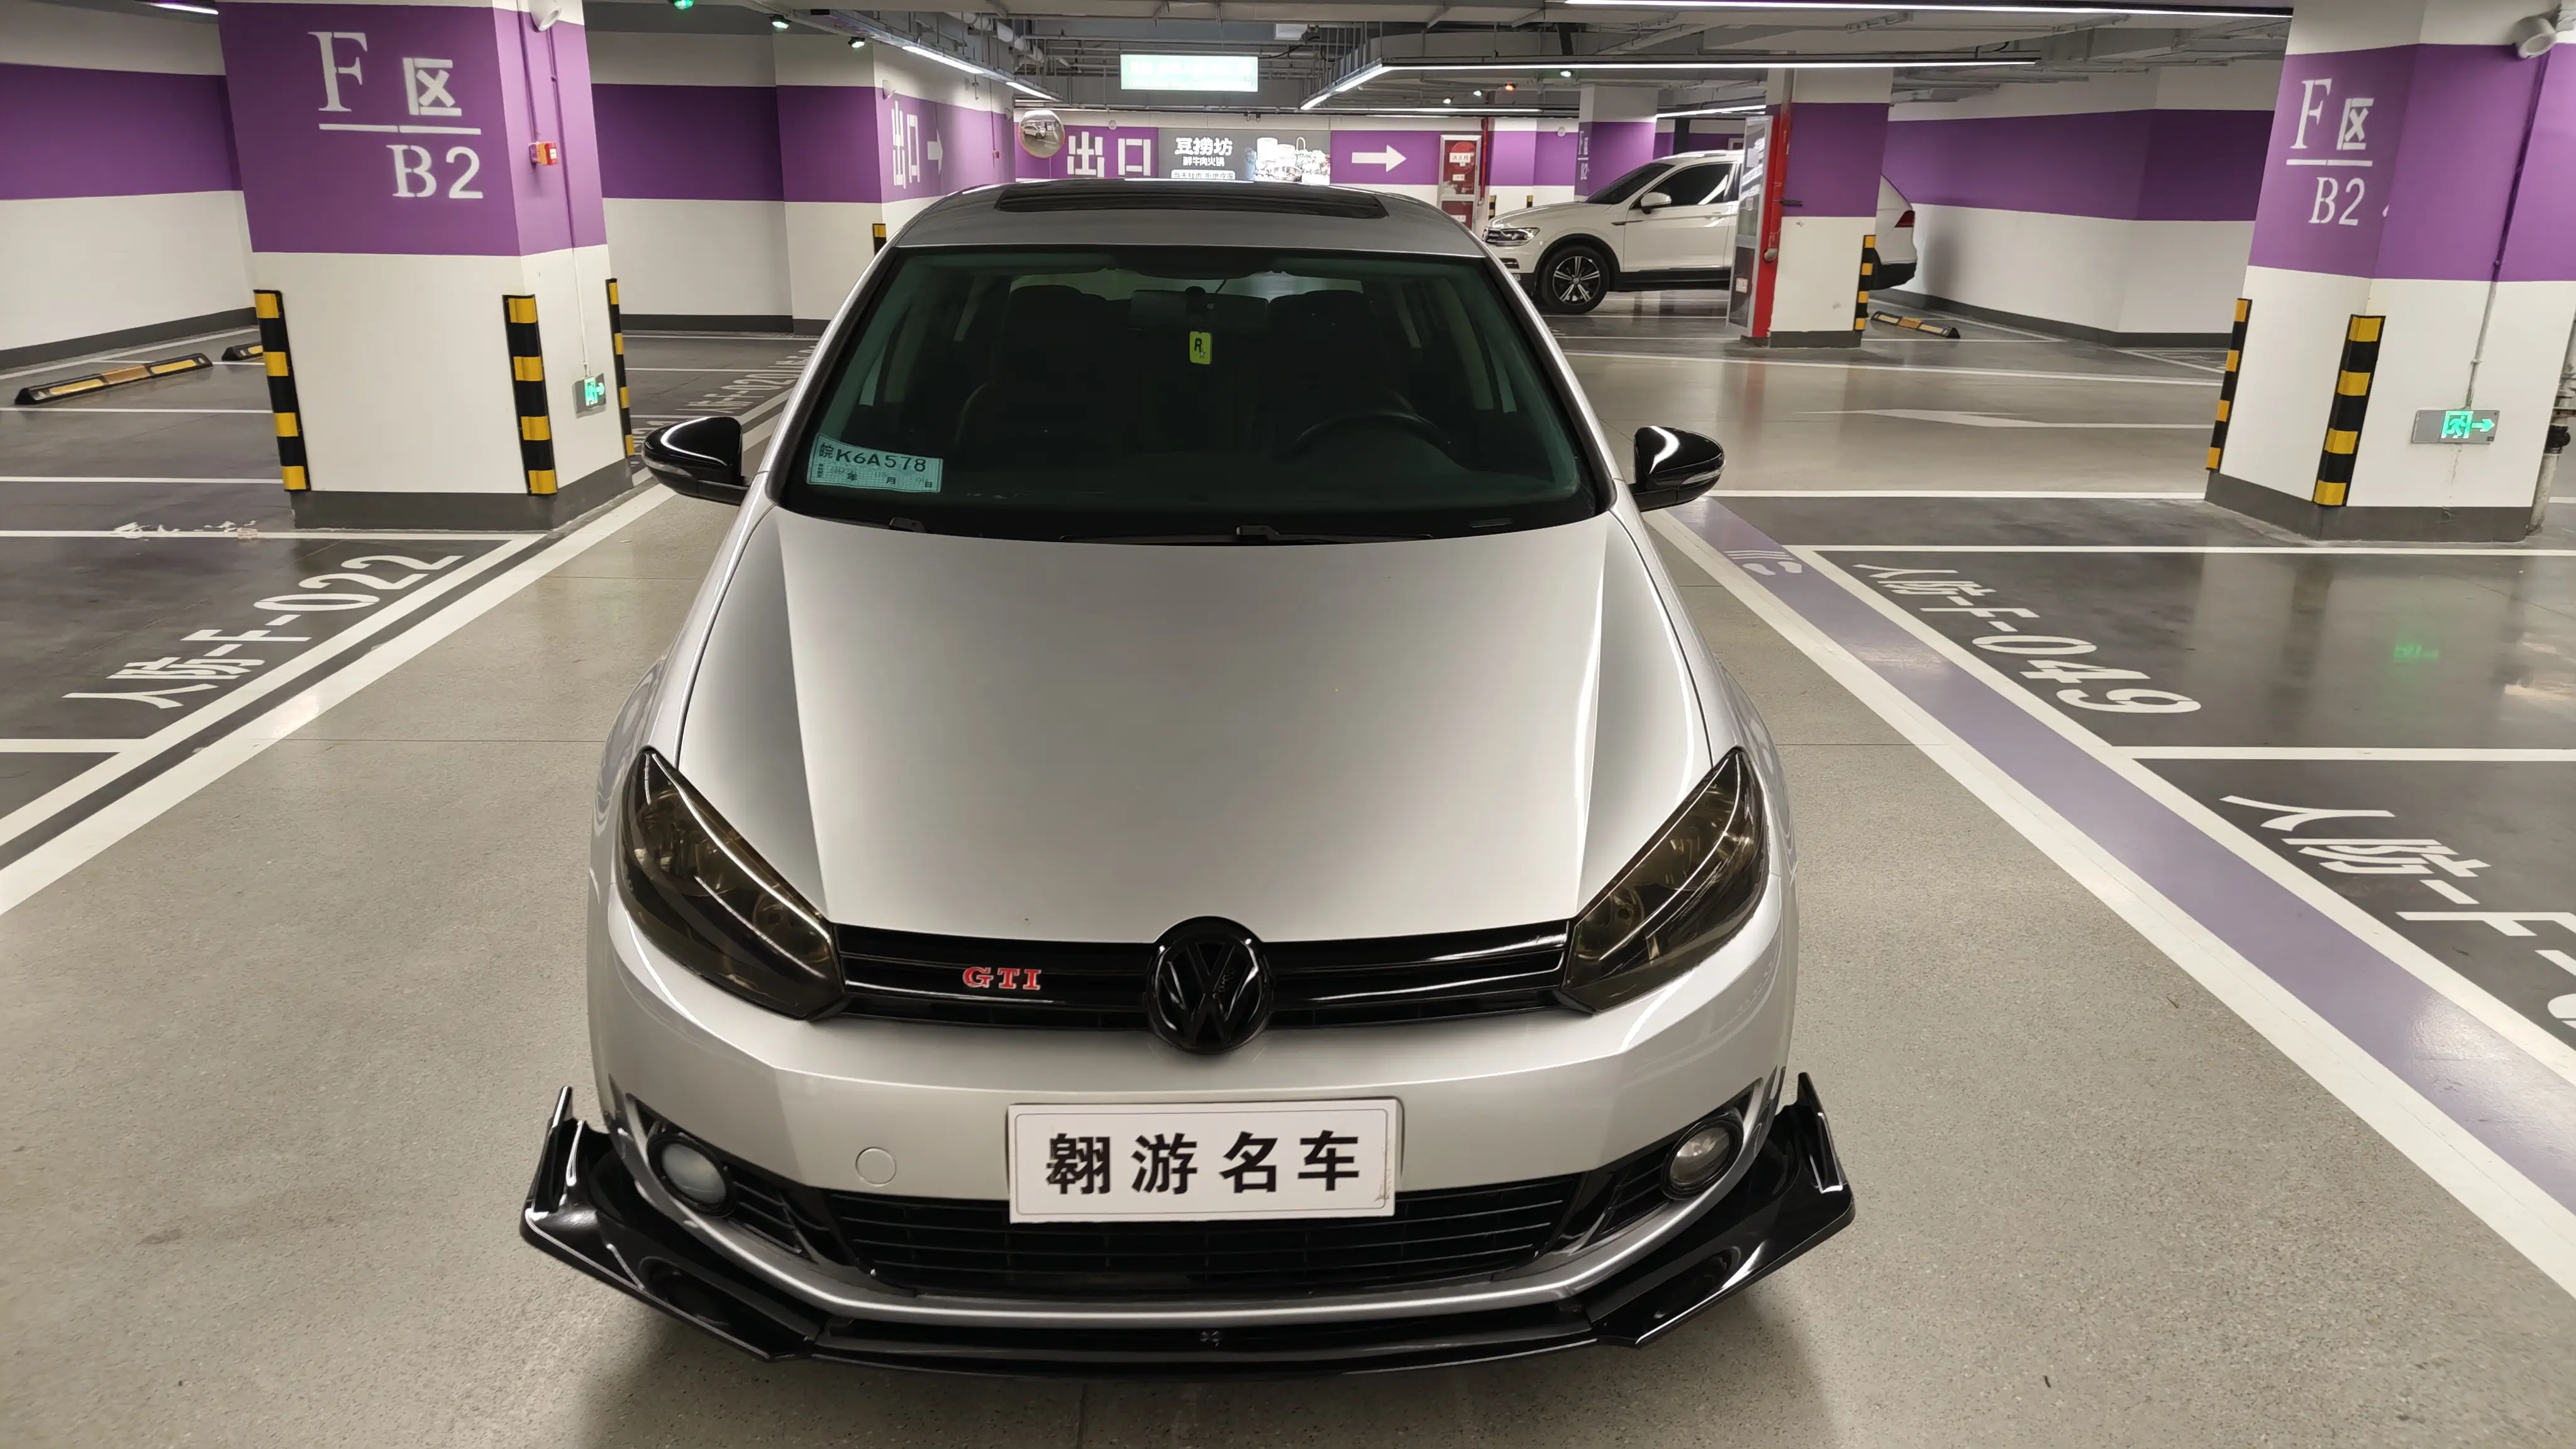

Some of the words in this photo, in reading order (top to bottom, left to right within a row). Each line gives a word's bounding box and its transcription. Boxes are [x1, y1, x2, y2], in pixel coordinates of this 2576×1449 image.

[891, 99, 921, 189] 出口
[1067, 131, 1151, 178] 出口
[1174, 137, 1233, 156] 豆捞坊
[386, 145, 484, 199] B2
[2308, 177, 2365, 225] B2
[818, 443, 926, 472] 皖K6A578
[962, 966, 1041, 991] GTI
[1046, 1130, 1360, 1195] 翱游名车
